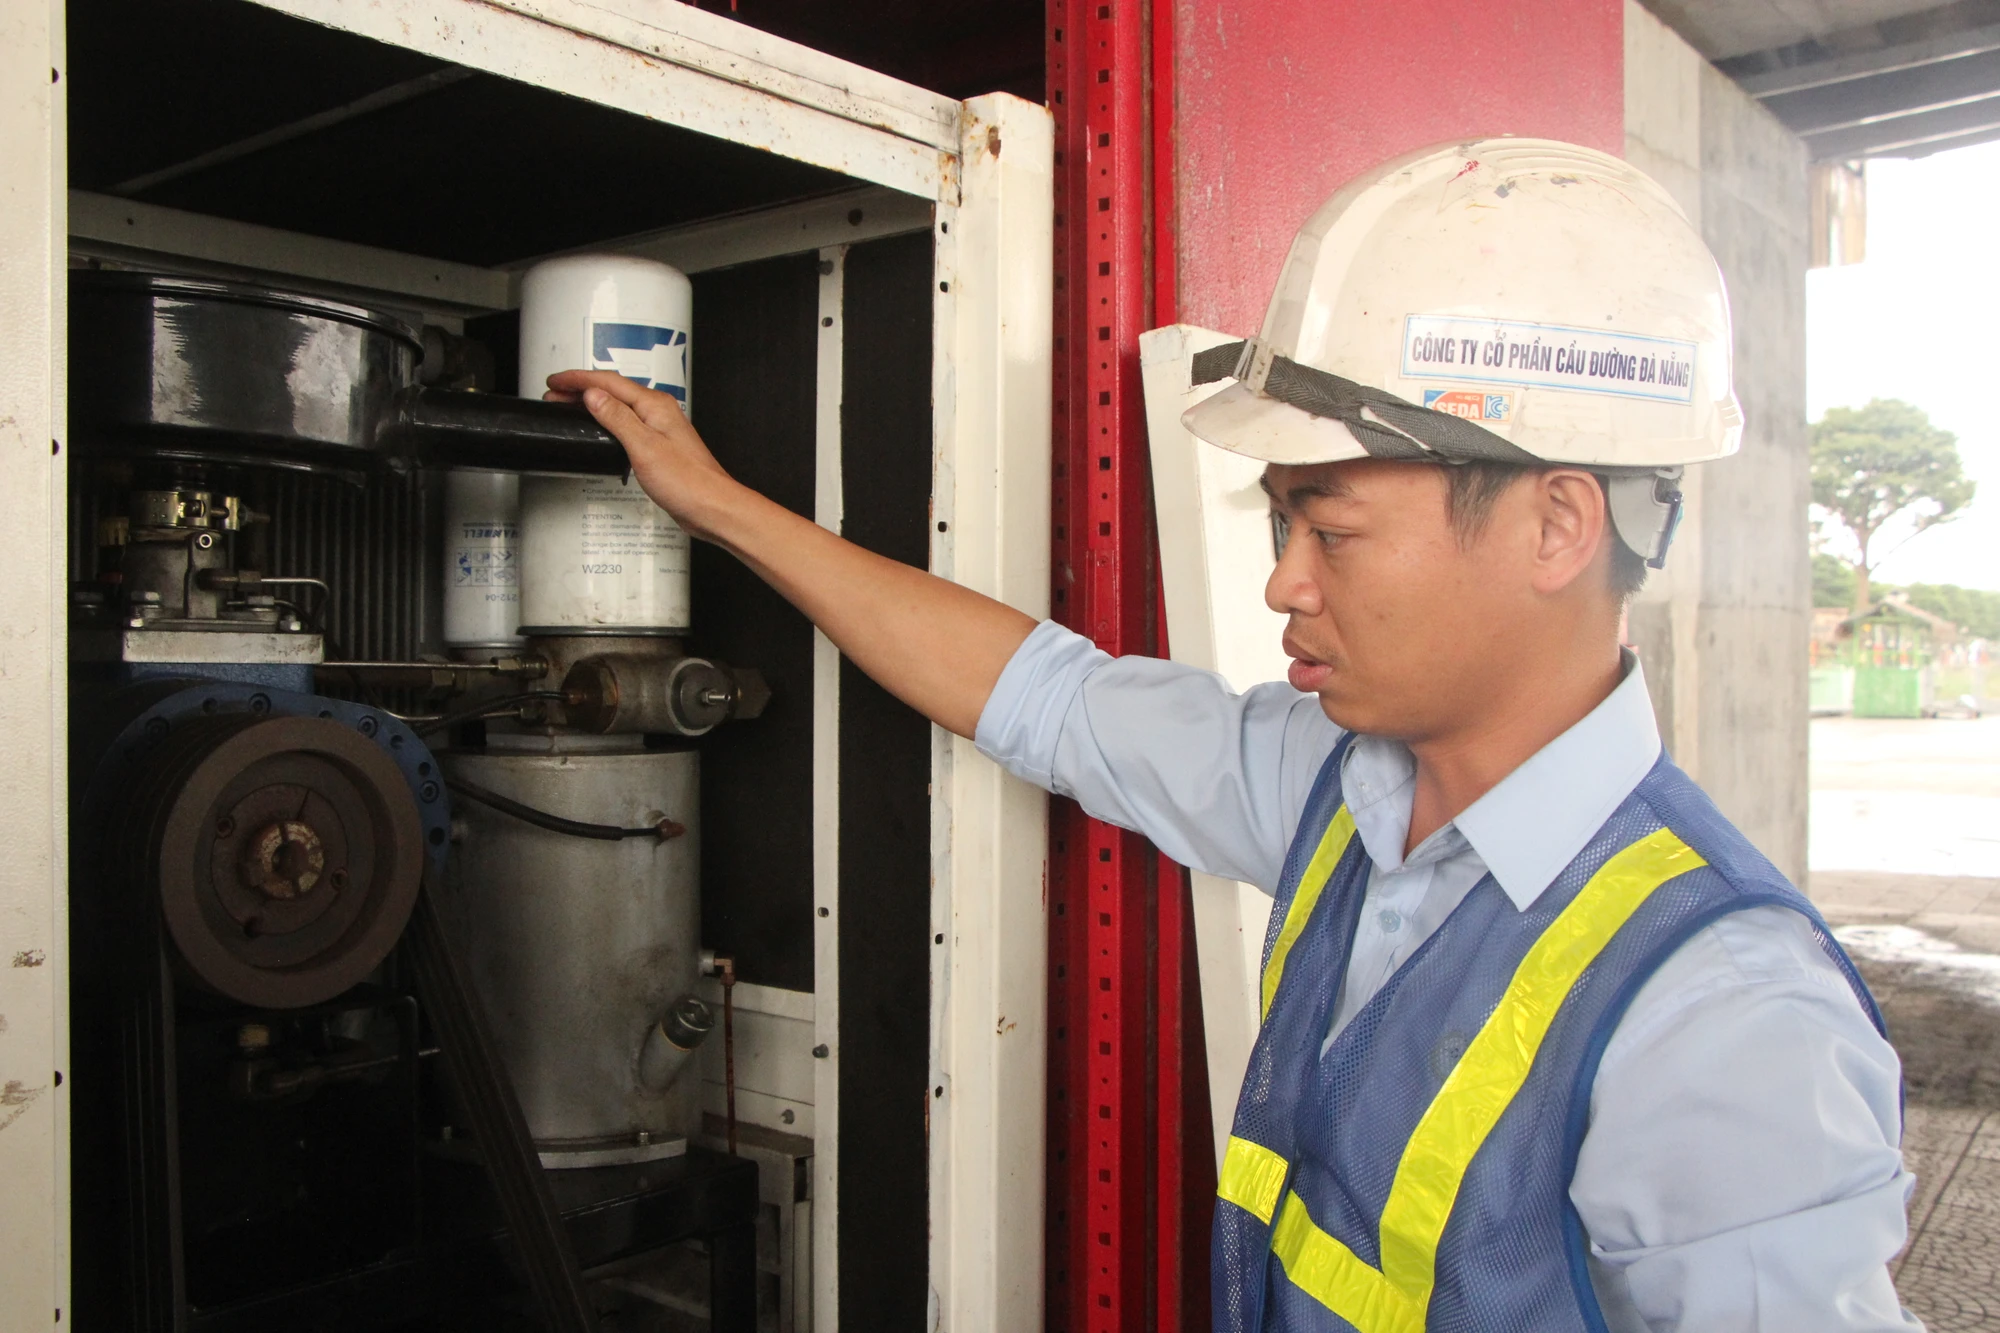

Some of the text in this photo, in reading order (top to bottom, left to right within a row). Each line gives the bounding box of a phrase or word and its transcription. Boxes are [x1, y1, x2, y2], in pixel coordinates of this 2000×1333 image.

[1412, 331, 1456, 364] CÔNG
[1460, 338, 1479, 366] TY
[1508, 336, 1553, 371] PHẦN
[1555, 340, 1586, 376] CẦU
[1588, 346, 1637, 381] ĐƯỜNG
[1639, 353, 1656, 384] ĐÀ
[582, 564, 622, 574] W2230
